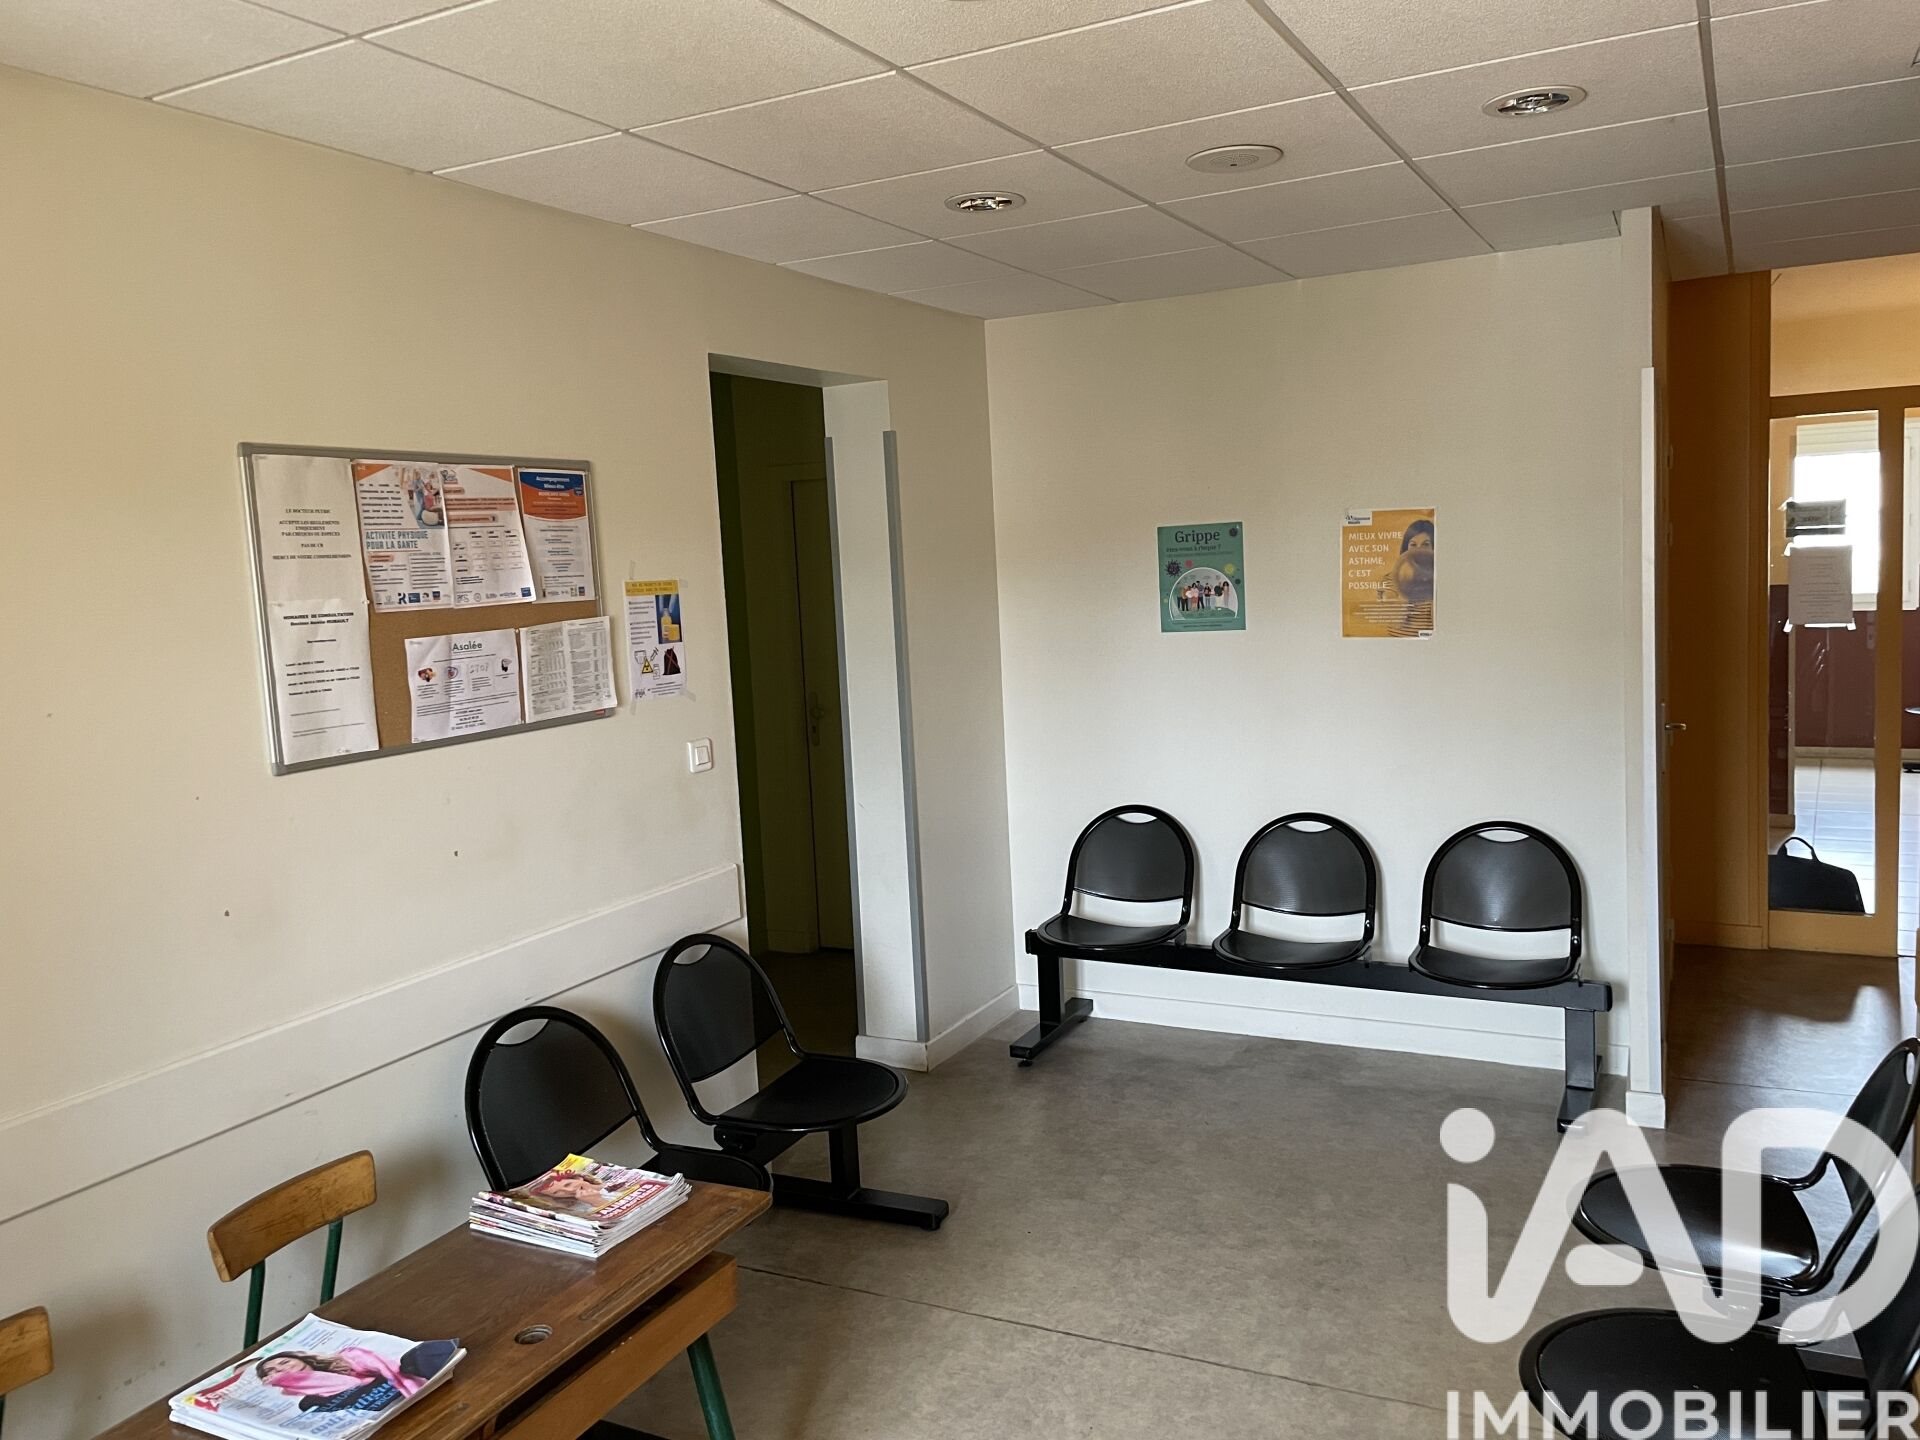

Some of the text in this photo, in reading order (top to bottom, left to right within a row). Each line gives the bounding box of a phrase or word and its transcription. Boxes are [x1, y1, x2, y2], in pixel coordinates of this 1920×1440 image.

[1174, 530, 1221, 544] Grippe
[1348, 531, 1403, 541] MIEUX VIVRE
[366, 541, 384, 549] POUR
[385, 541, 396, 549] LA
[1348, 543, 1389, 553] AVEC SON
[1348, 556, 1385, 566] ASTHME,
[453, 641, 483, 651] Asalée
